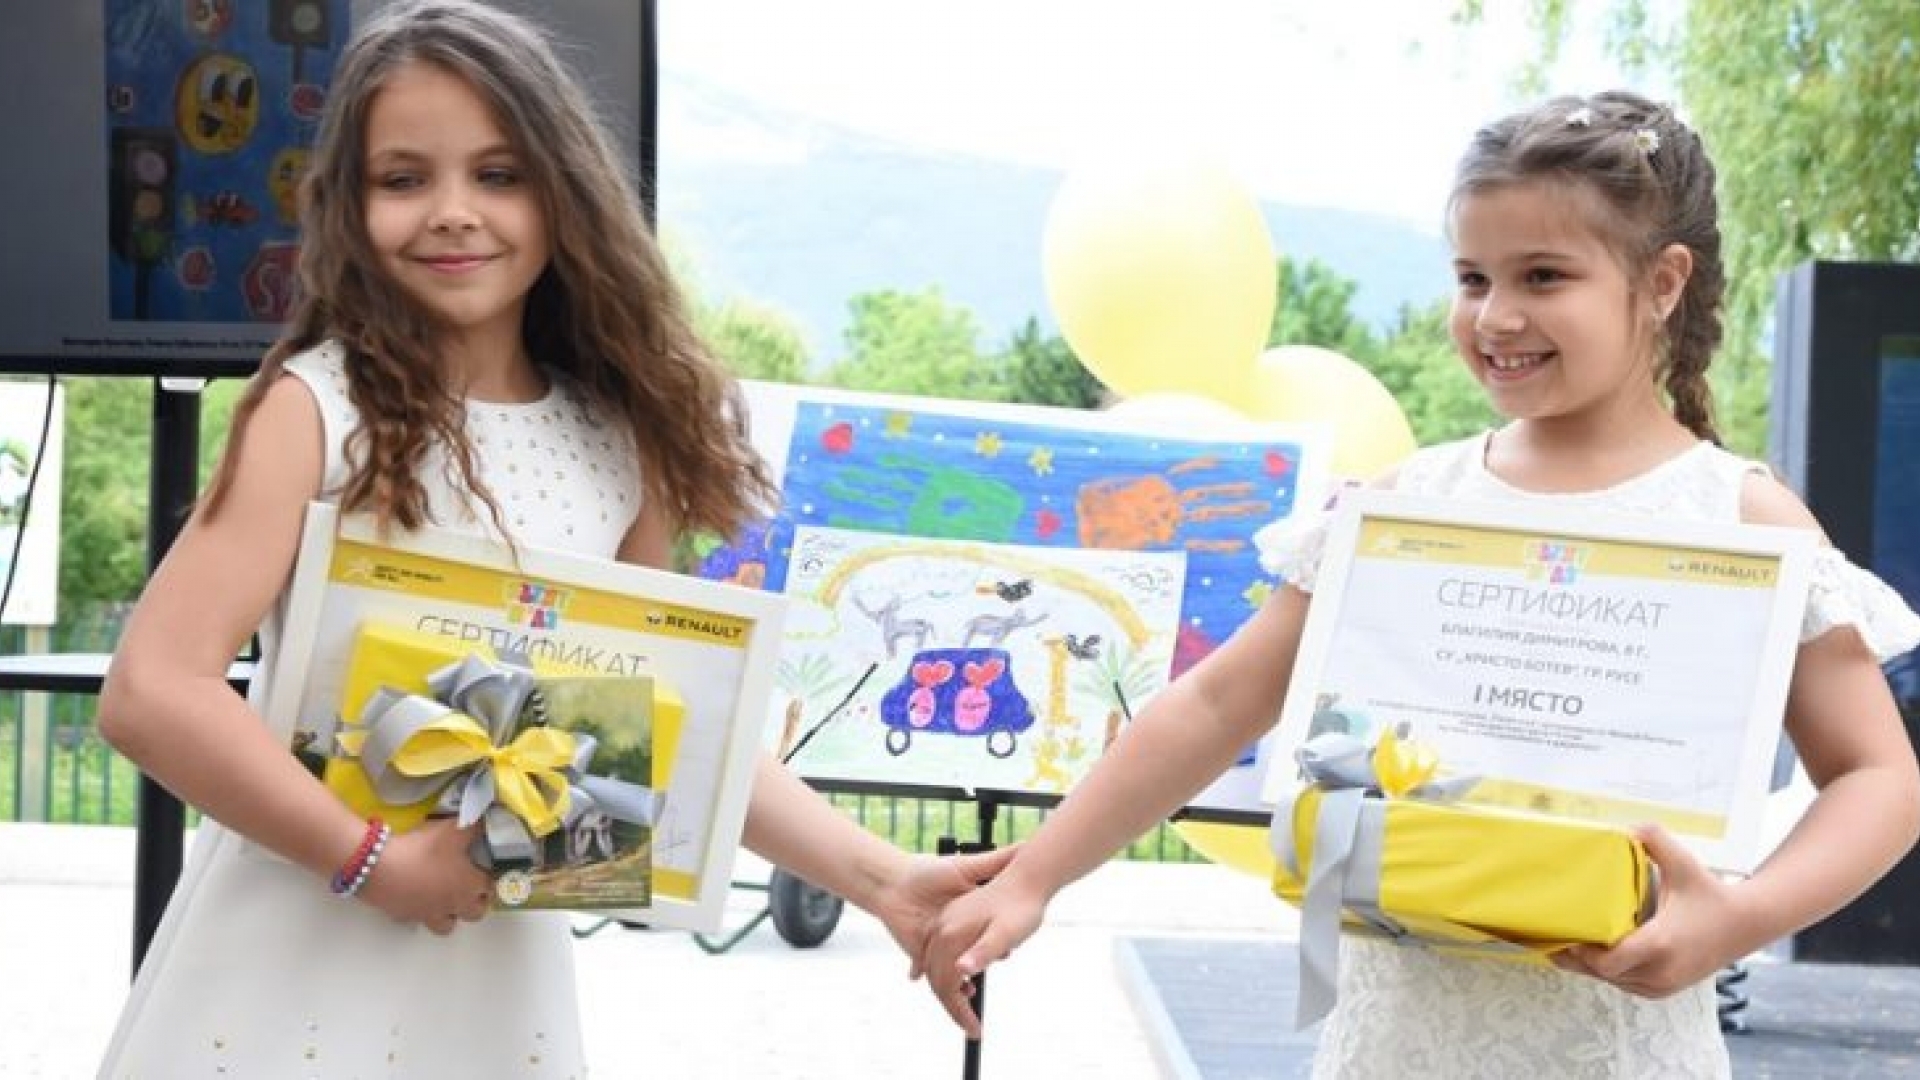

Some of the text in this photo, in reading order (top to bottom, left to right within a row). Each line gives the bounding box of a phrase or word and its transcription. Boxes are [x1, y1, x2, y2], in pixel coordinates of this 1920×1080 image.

[1689, 563, 1770, 582] RENAULT
[1438, 578, 1669, 628] СЕРТИФИКАТ
[666, 614, 742, 638] RENAULT
[1488, 685, 1584, 716] МЯСТО
